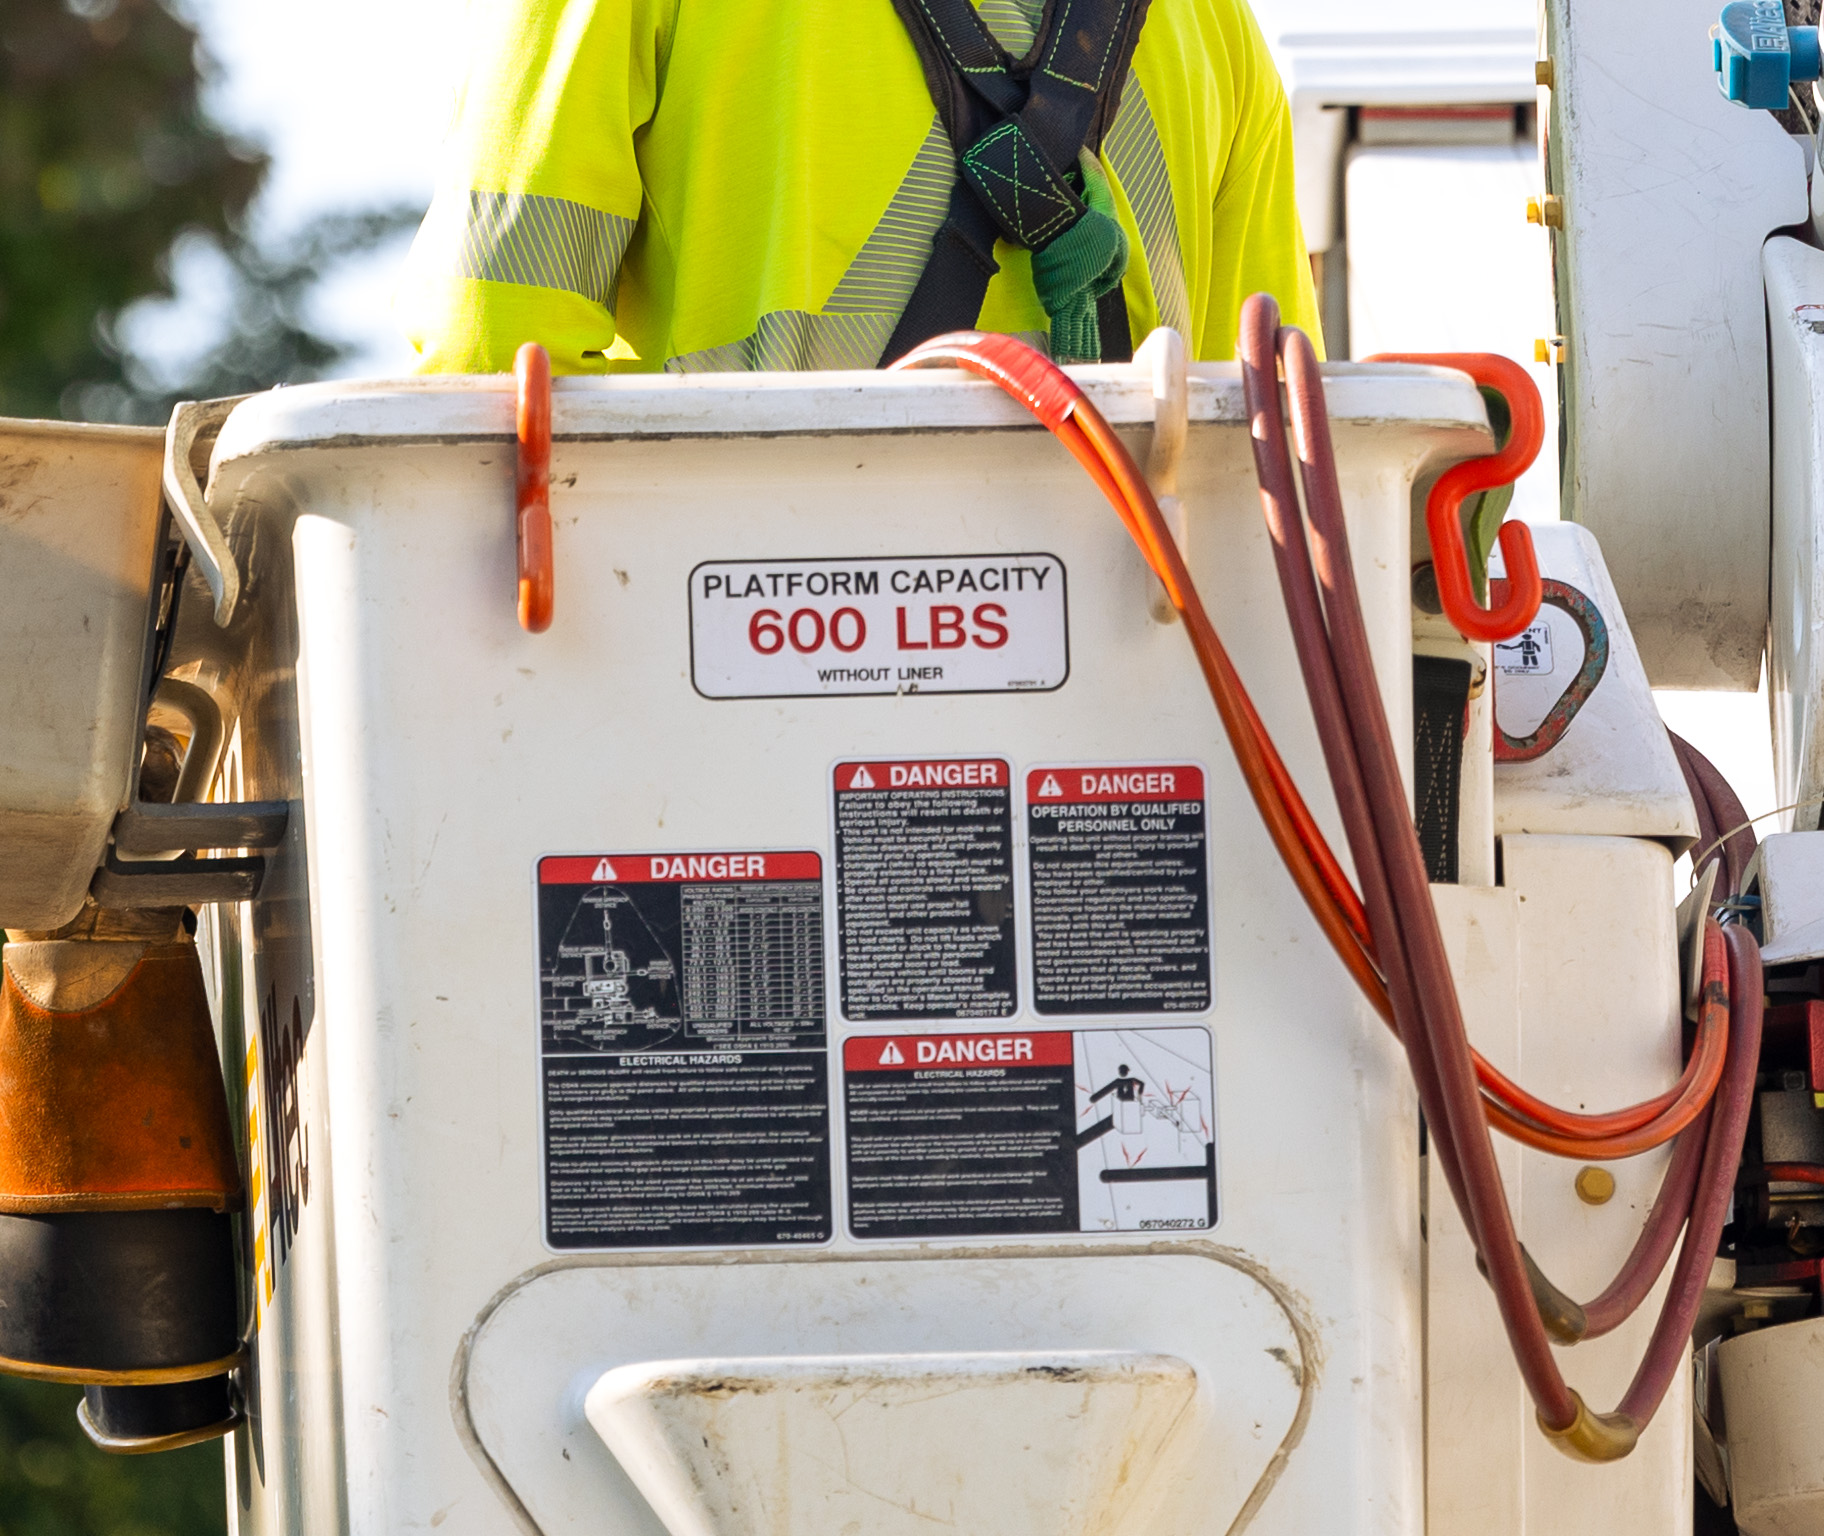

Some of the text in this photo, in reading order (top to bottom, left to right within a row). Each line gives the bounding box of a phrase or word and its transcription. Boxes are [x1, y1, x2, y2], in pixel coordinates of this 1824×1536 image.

[704, 567, 1050, 598] PLATFORM CAPACITY
[748, 603, 1009, 655] 600 LBS
[818, 667, 943, 682] WITHOUT LINER
[890, 764, 997, 786] DANGER
[1081, 773, 1175, 795] DANGER
[838, 789, 1005, 800] IMPORTANT OPERATING INSTRUCTIONS
[1032, 803, 1201, 818] OPERATION BY QUALIFIED
[1058, 818, 1176, 832] PERSONNEL ONLY
[651, 856, 765, 879] DANGER
[619, 1055, 743, 1066] ELECTRICAL HAZARDS
[917, 1039, 1033, 1063] DANGER
[914, 1069, 1006, 1079] ELECTRICAL HAZARDS
[261, 980, 309, 1293] Altec
